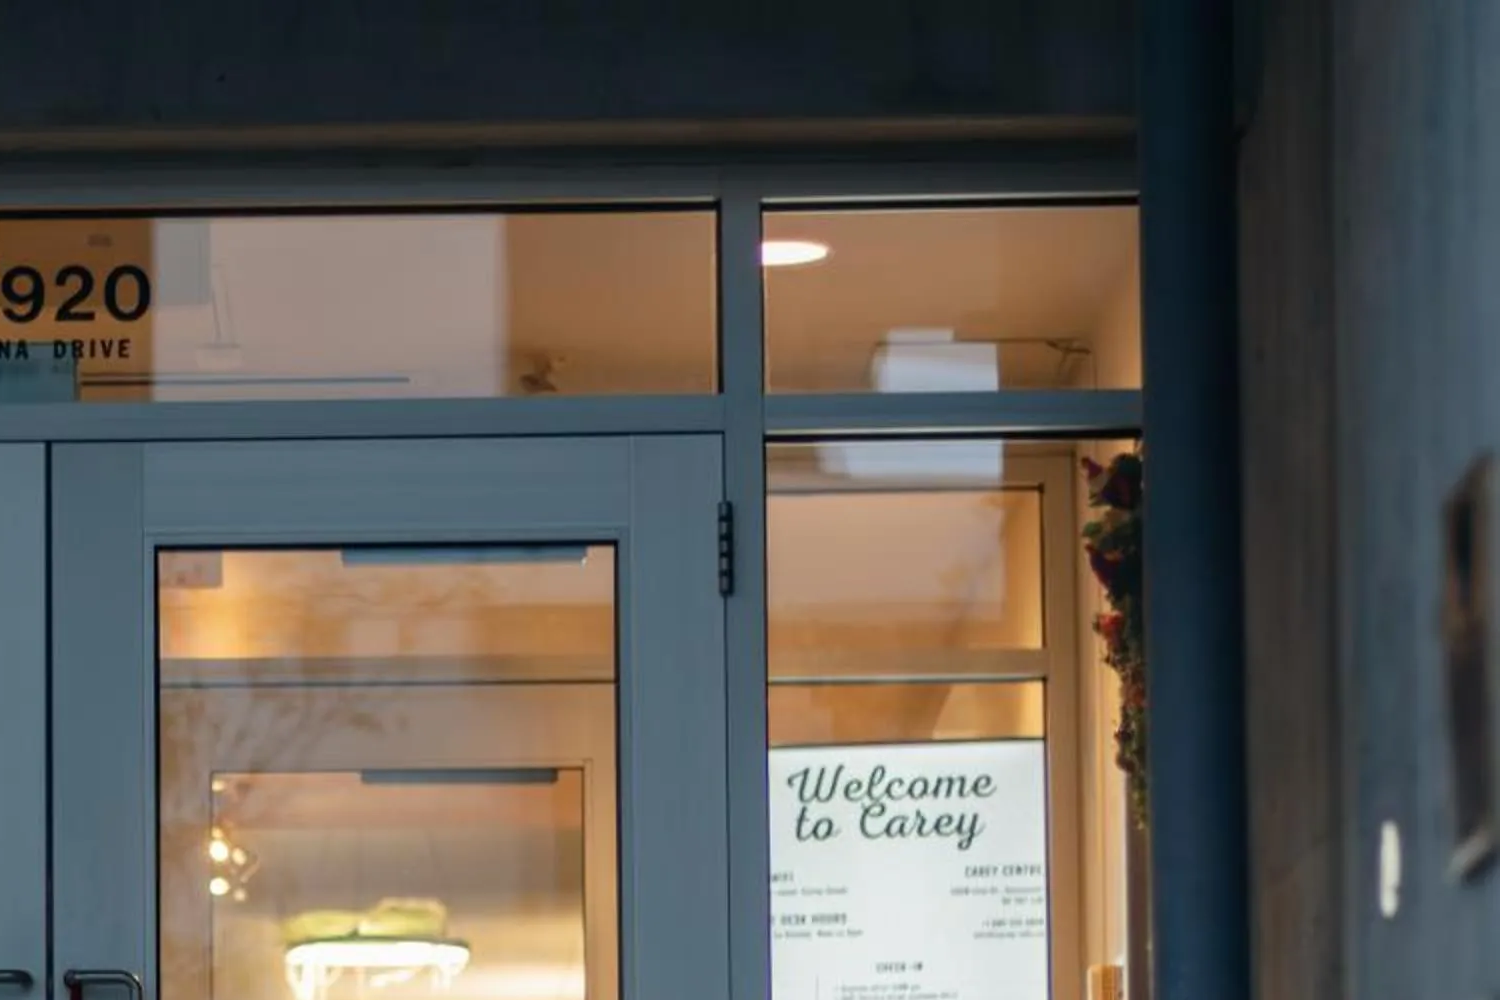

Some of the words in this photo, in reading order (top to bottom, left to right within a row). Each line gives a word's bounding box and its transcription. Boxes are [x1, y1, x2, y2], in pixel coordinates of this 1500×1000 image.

[53, 338, 131, 360] DRIVE
[787, 764, 997, 803] Welcome
[795, 806, 841, 842] to
[859, 802, 986, 851] Carey
